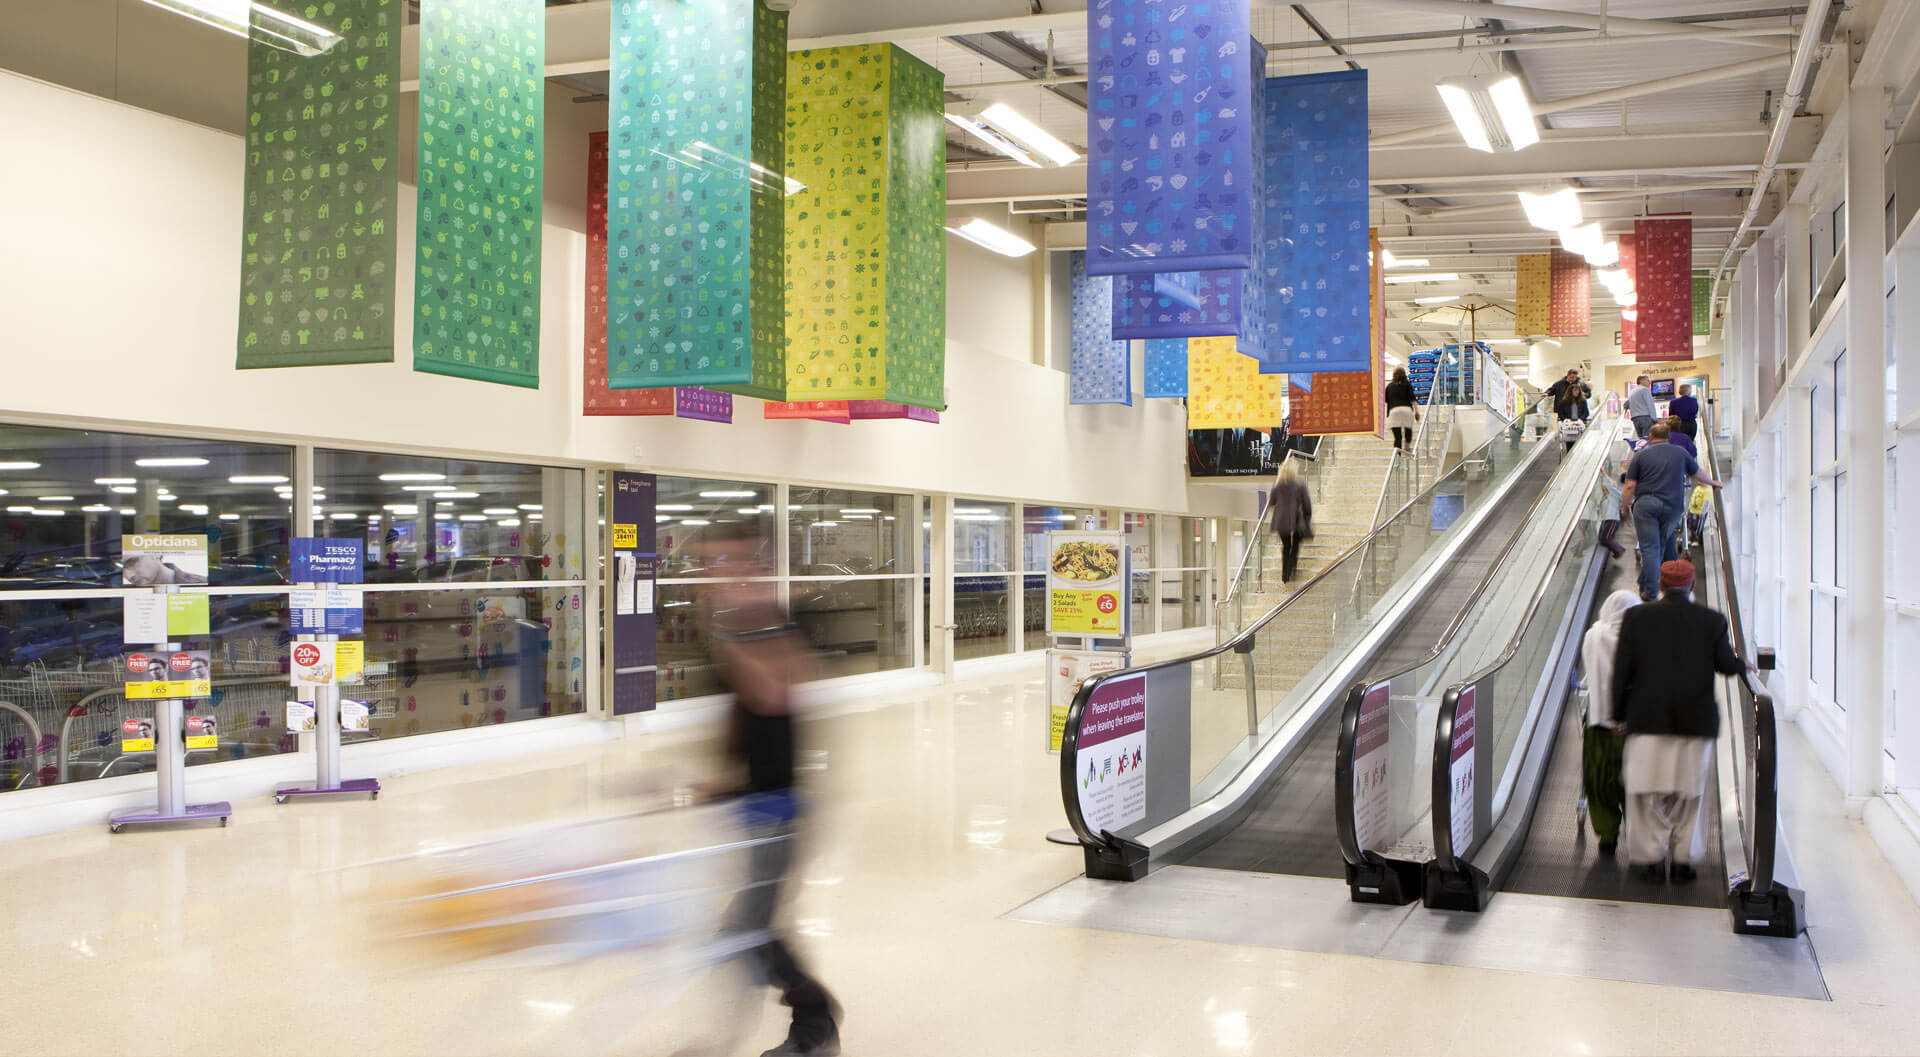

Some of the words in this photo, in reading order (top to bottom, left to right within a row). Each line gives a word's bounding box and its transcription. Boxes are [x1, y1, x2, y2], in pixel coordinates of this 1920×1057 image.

[132, 535, 198, 548] Opticians
[309, 555, 356, 564] Pharmacy
[1101, 599, 1113, 609] £6
[297, 648, 319, 657] 20%
[1092, 701, 1108, 715] Please
[1109, 698, 1121, 713] push
[1121, 696, 1131, 711] your
[1130, 692, 1144, 705] trolley
[1082, 723, 1097, 736] when
[1097, 719, 1114, 731] leaving
[1115, 715, 1123, 726] the
